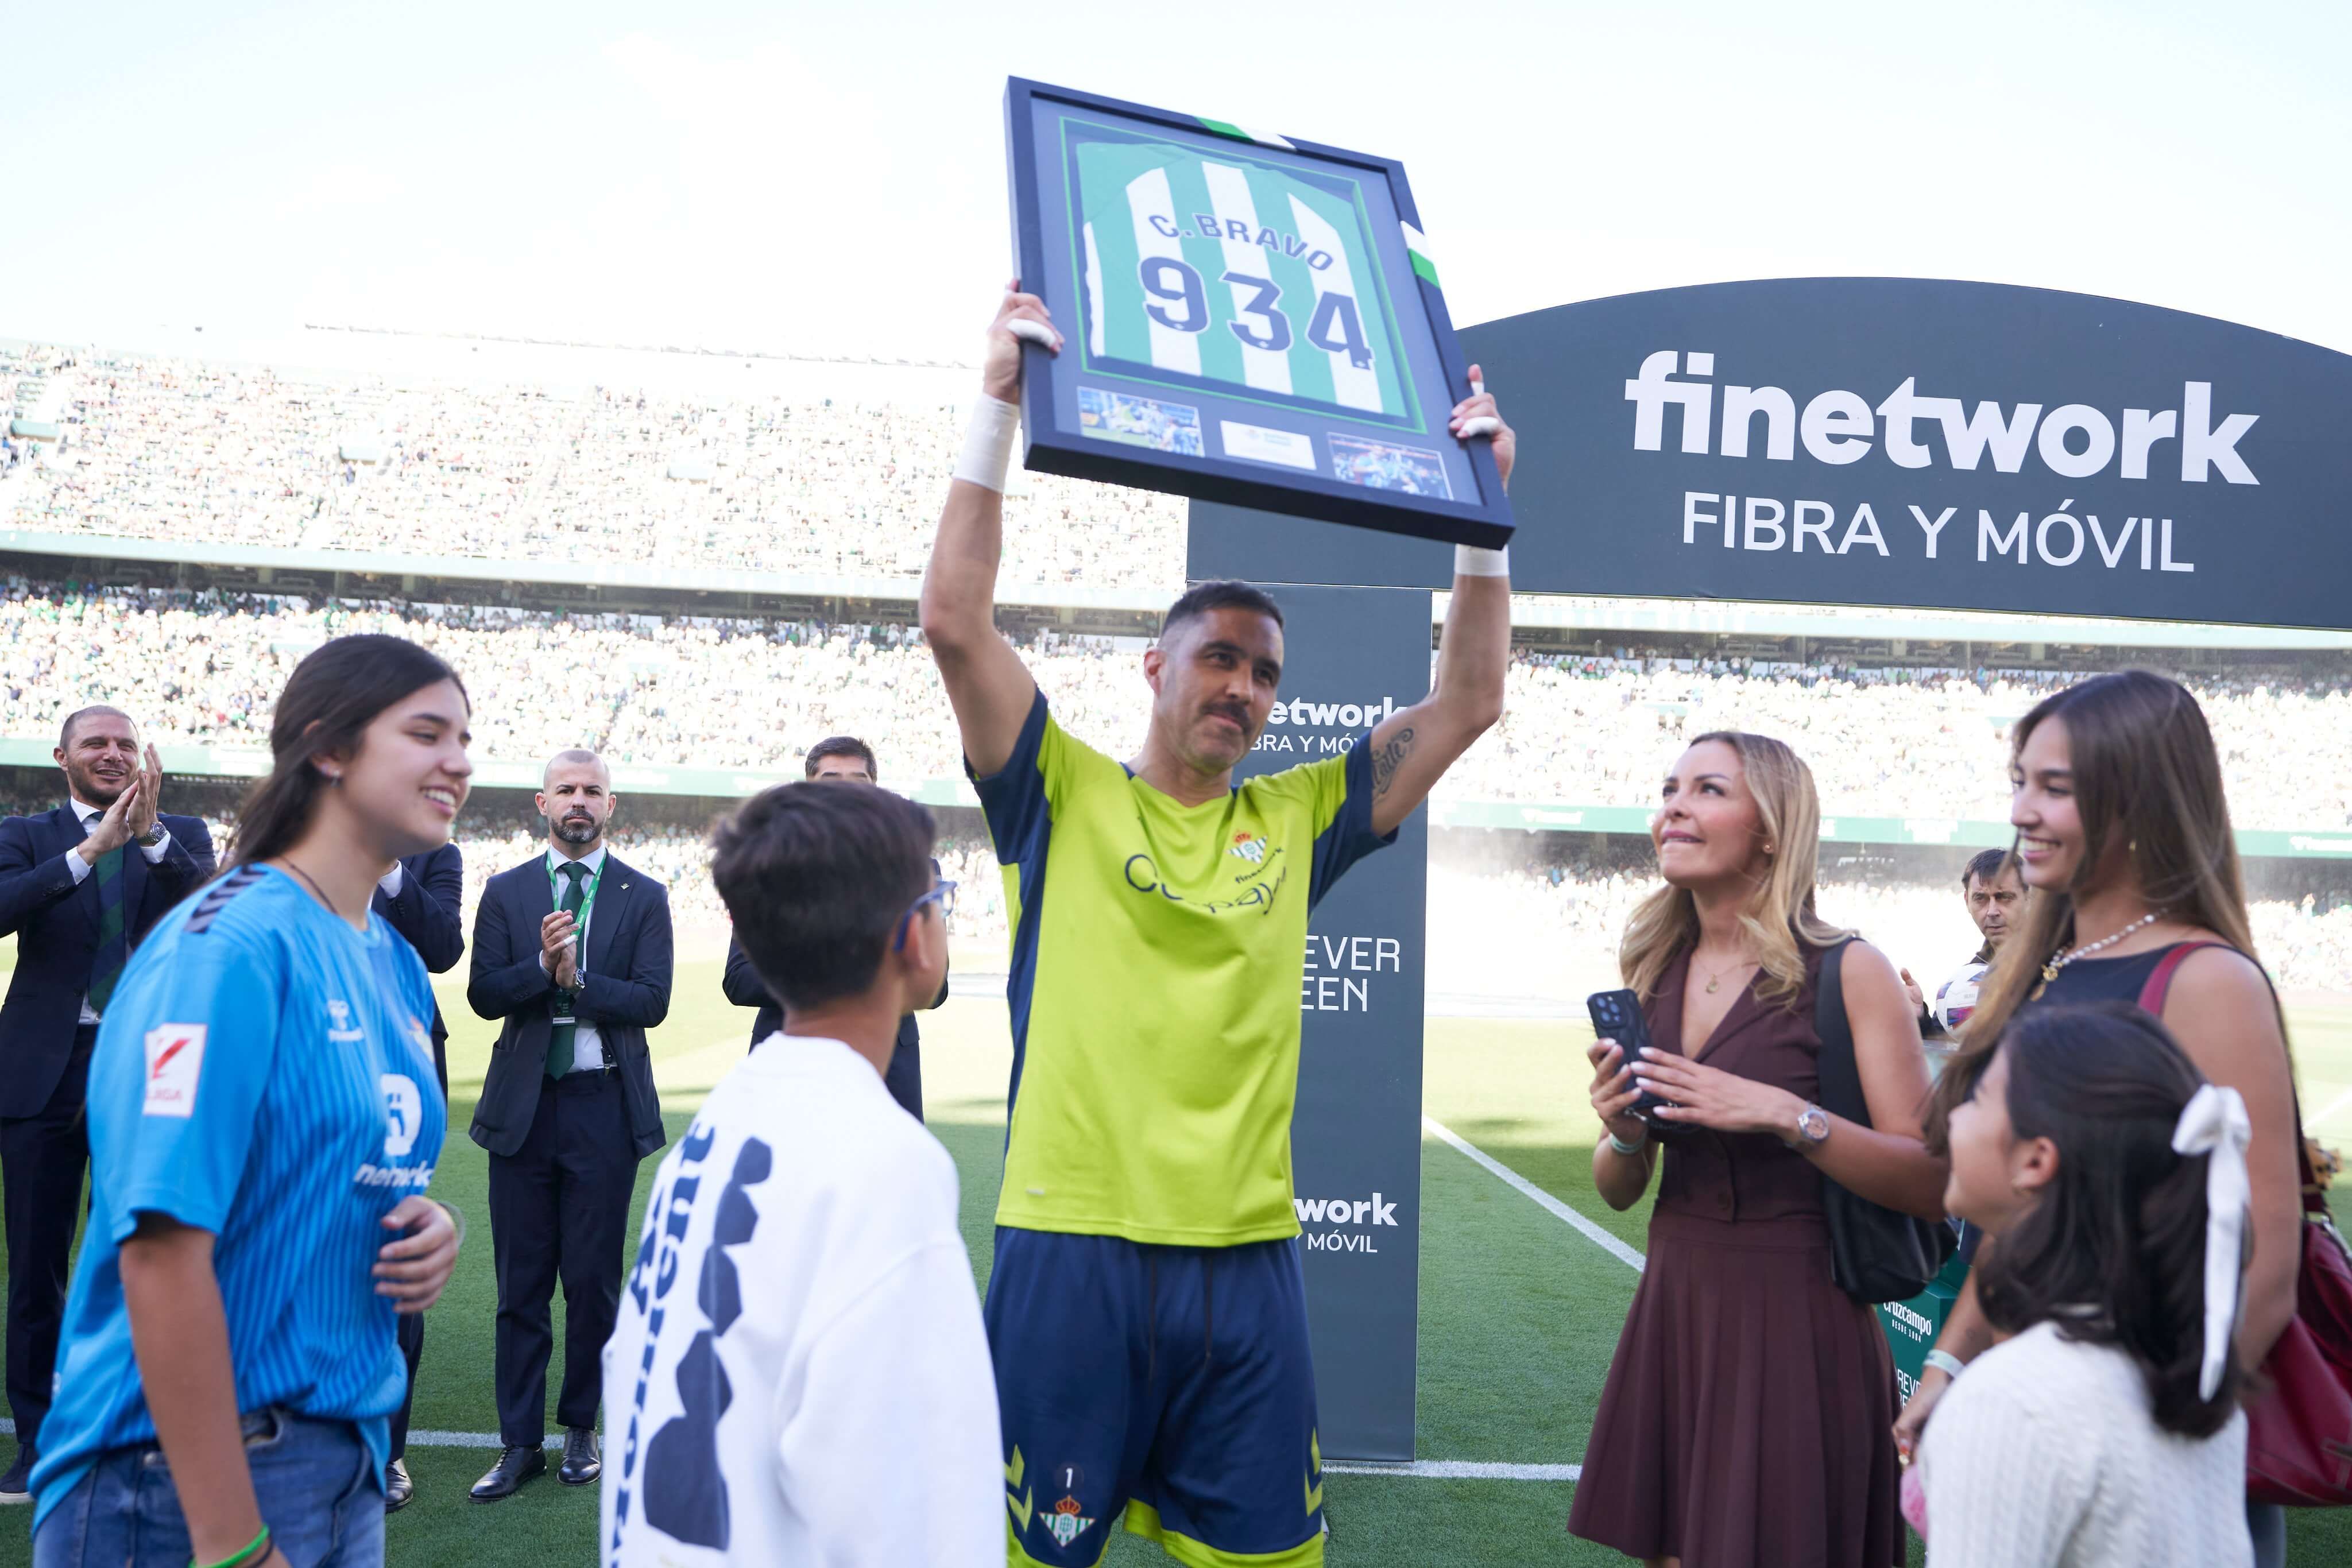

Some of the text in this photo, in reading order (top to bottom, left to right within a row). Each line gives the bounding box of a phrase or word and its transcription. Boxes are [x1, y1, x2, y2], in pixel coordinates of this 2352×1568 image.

[1139, 256, 1375, 370] 934
[1625, 350, 2261, 485] finetwork
[1683, 491, 2195, 573] FIBRA Y MÓVIL
[1267, 696, 1408, 727] etwork
[1250, 733, 1359, 754] BRA Y MÓ
[1302, 935, 1400, 972] EVER
[1300, 976, 1368, 1012] EEN
[1293, 1193, 1399, 1226] work
[1308, 1229, 1378, 1253] MÓVIL
[1065, 1468, 1073, 1488] 1
